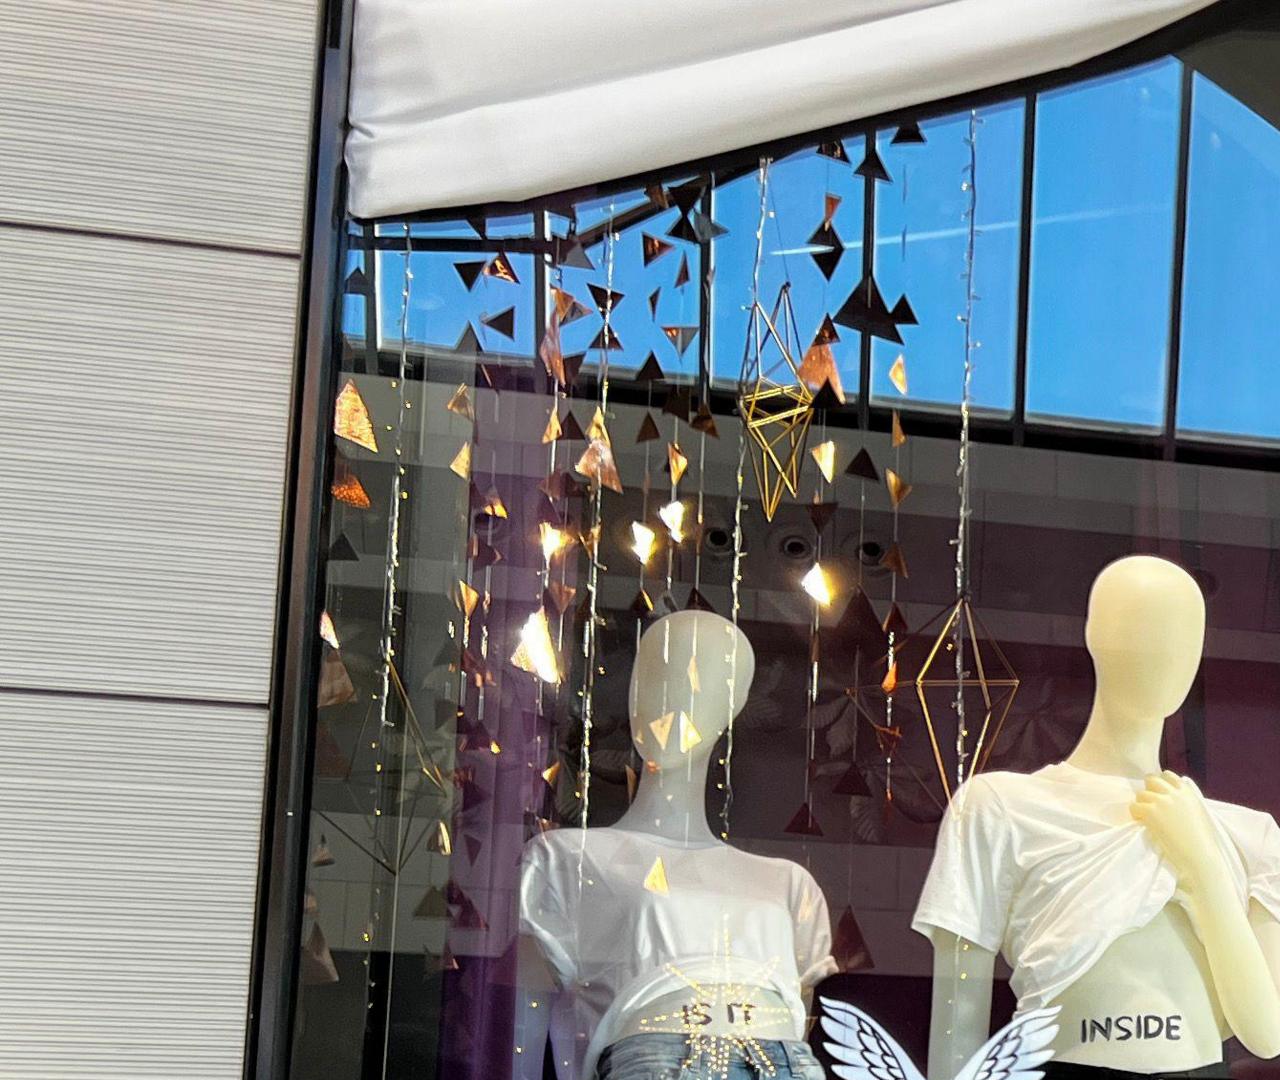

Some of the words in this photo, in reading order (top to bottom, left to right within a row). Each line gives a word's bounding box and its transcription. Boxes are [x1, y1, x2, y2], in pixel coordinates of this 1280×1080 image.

[682, 1001, 713, 1026] IS
[726, 1002, 757, 1024] IT
[1081, 1014, 1182, 1043] INSIDE
